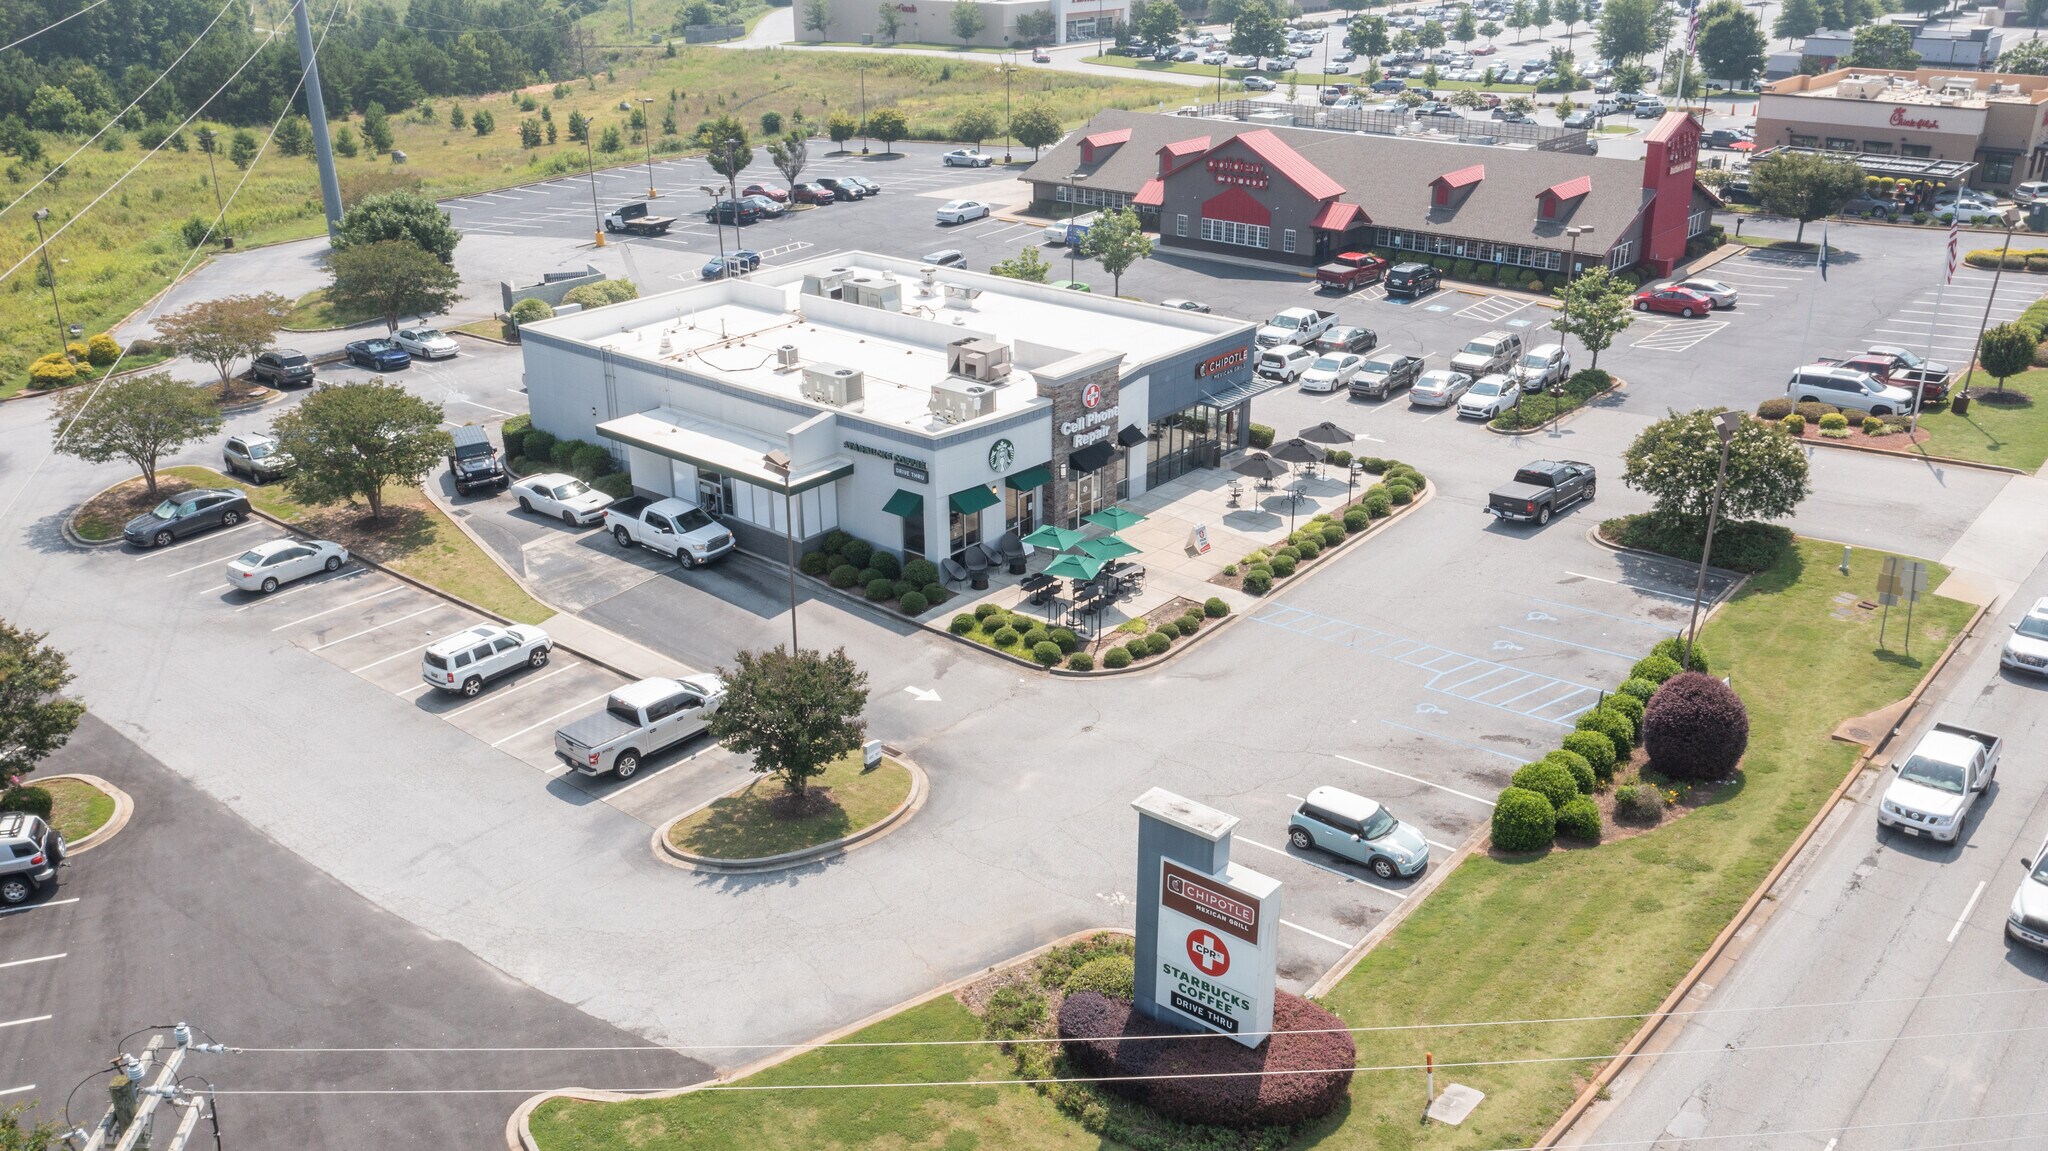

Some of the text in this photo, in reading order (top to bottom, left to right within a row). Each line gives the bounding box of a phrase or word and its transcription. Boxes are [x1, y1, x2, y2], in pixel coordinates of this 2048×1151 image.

[1209, 349, 1248, 372] CHIPOTLE
[1060, 405, 1120, 436] Cell Phone
[1072, 424, 1110, 448] Repair
[895, 467, 925, 481] DRIVE THRU
[1186, 886, 1251, 921] CHIPOTLE
[1196, 904, 1250, 932] MEXICAN GRILL
[1162, 962, 1251, 1011] STARBUCKS
[1178, 983, 1233, 1015] COFFEE
[1176, 997, 1233, 1030] DRIVE THRU
